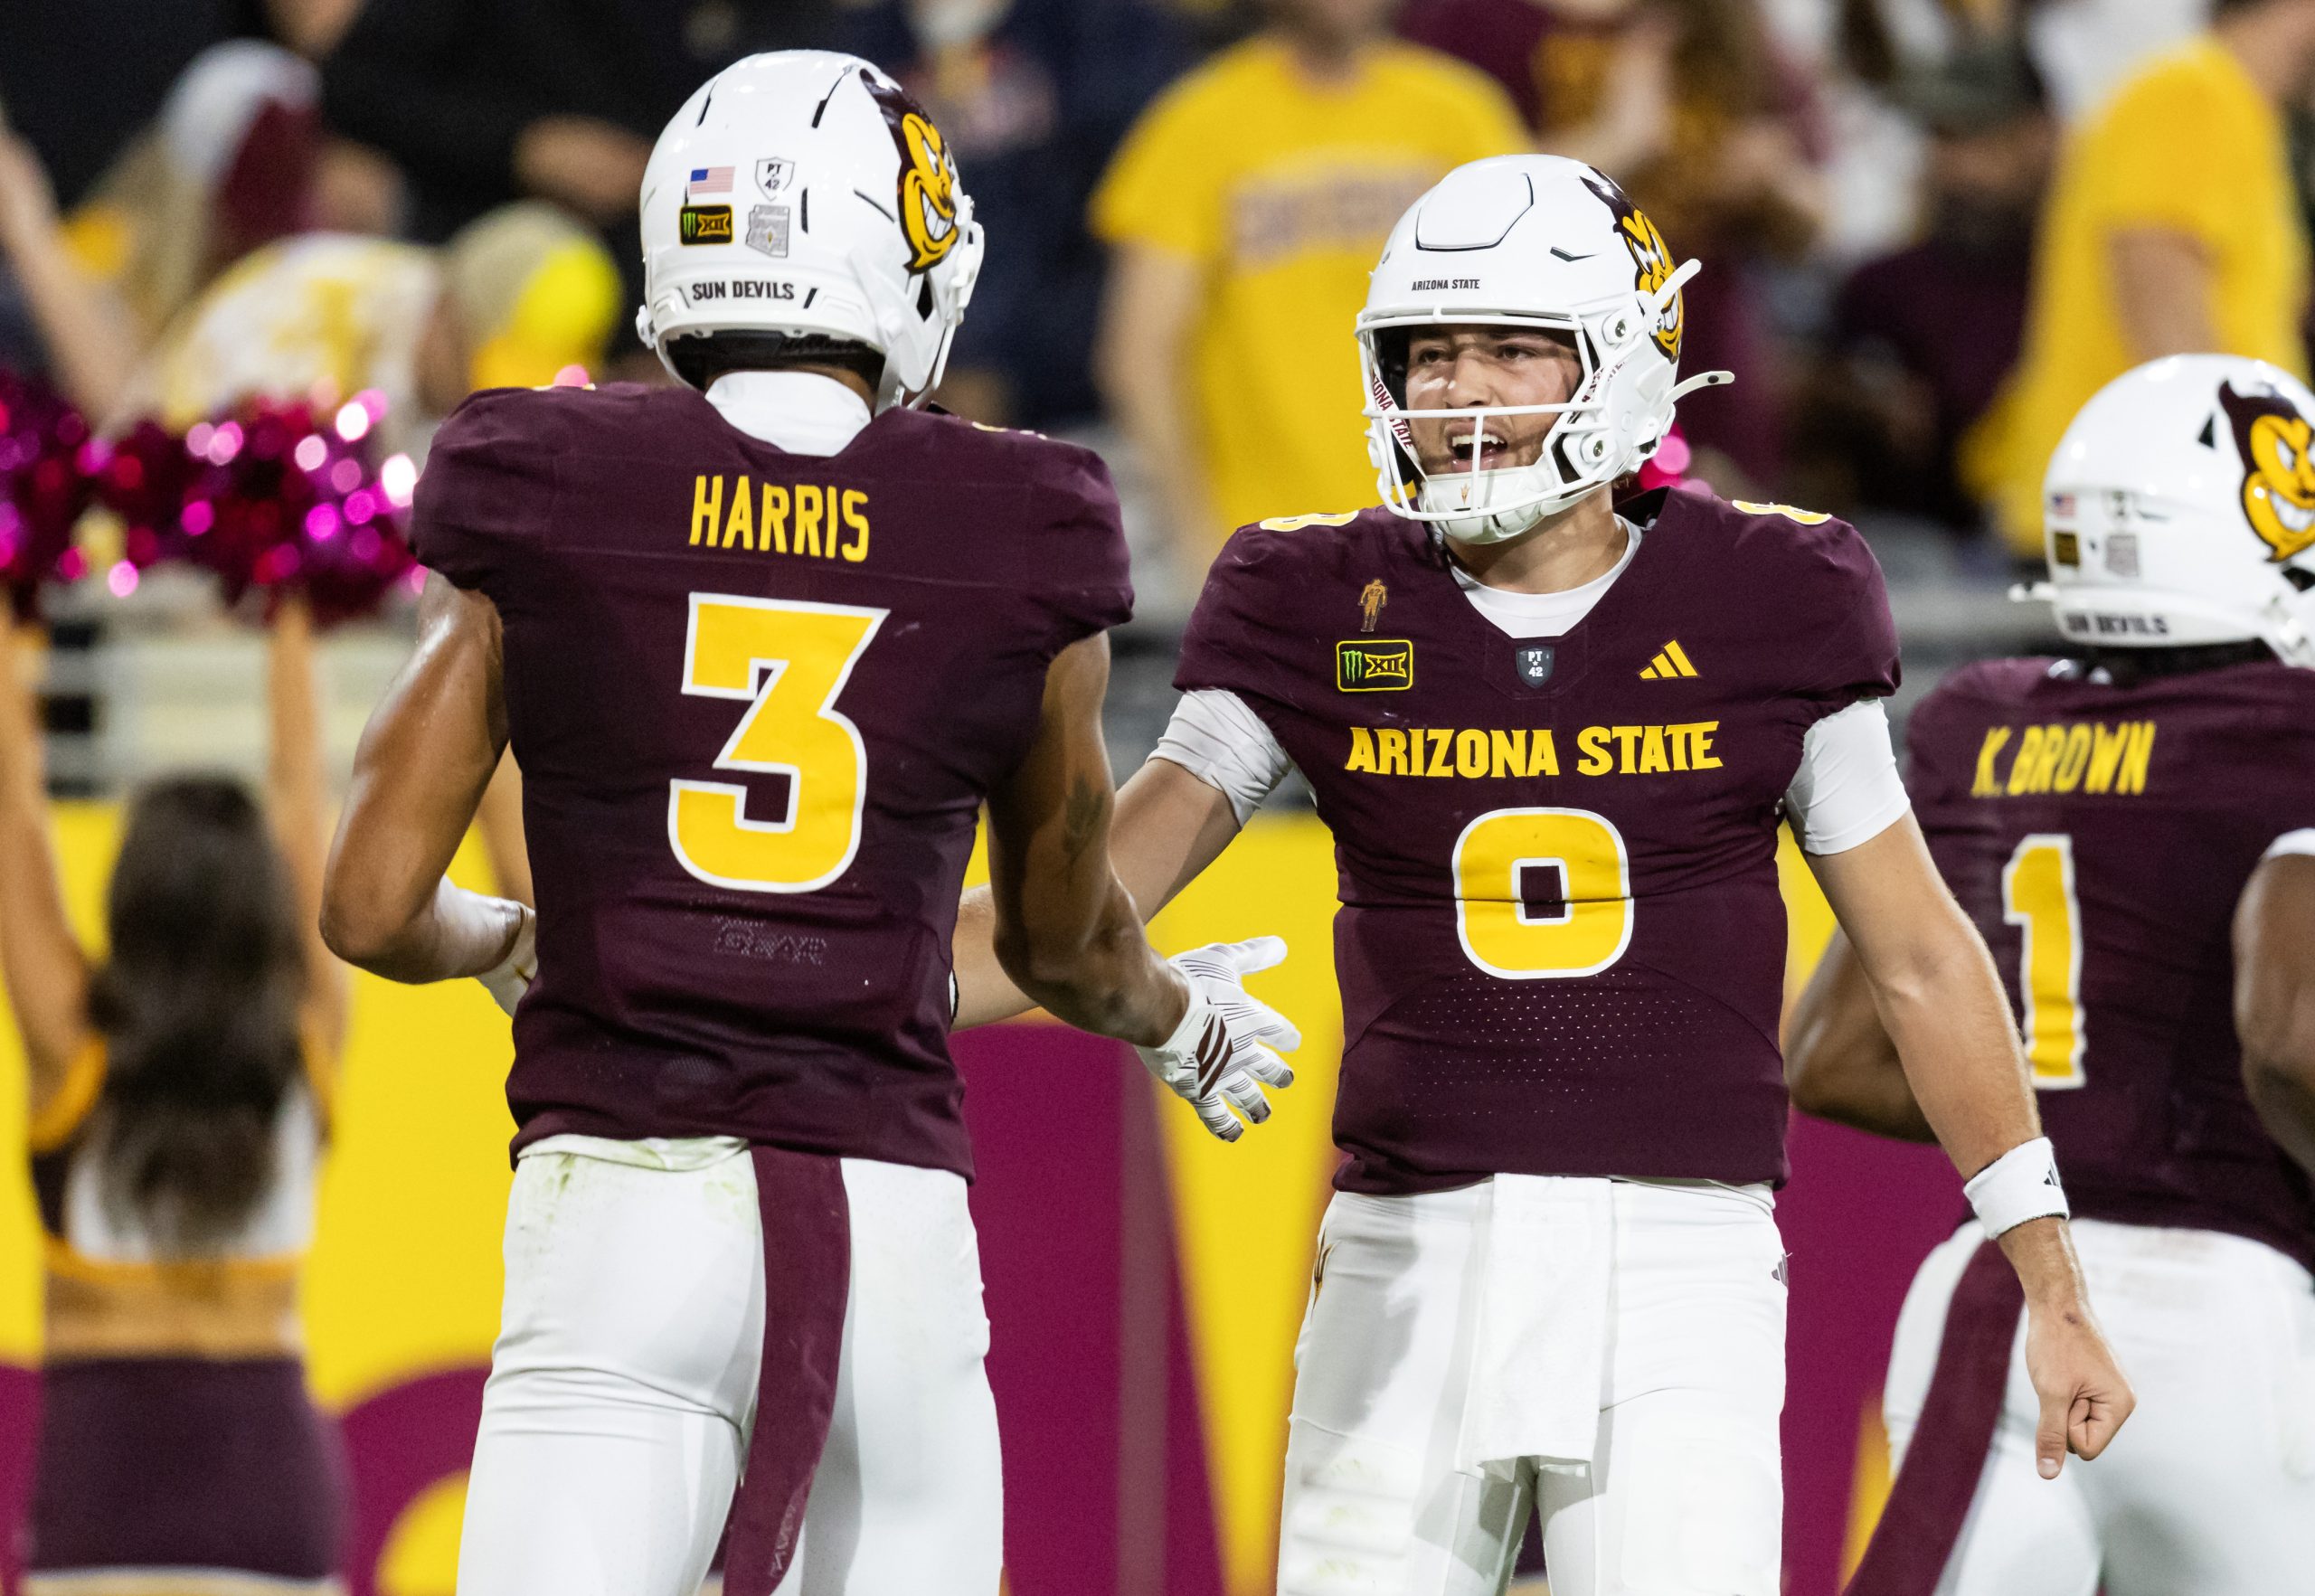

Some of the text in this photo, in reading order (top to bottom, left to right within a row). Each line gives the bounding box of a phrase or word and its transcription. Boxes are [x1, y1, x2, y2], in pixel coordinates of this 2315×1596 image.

[767, 163, 782, 175] PT
[692, 280, 795, 301] SUN DEVILS
[1411, 279, 1480, 291] ARIZONA STATE
[1389, 417, 1414, 449] TATE
[689, 475, 870, 563] HARRIS
[1527, 650, 1543, 662] PT
[1528, 666, 1544, 677] 42
[667, 590, 891, 894] 3
[1345, 721, 1724, 778] ARIZONA STATE
[2001, 833, 2087, 1090] 1
